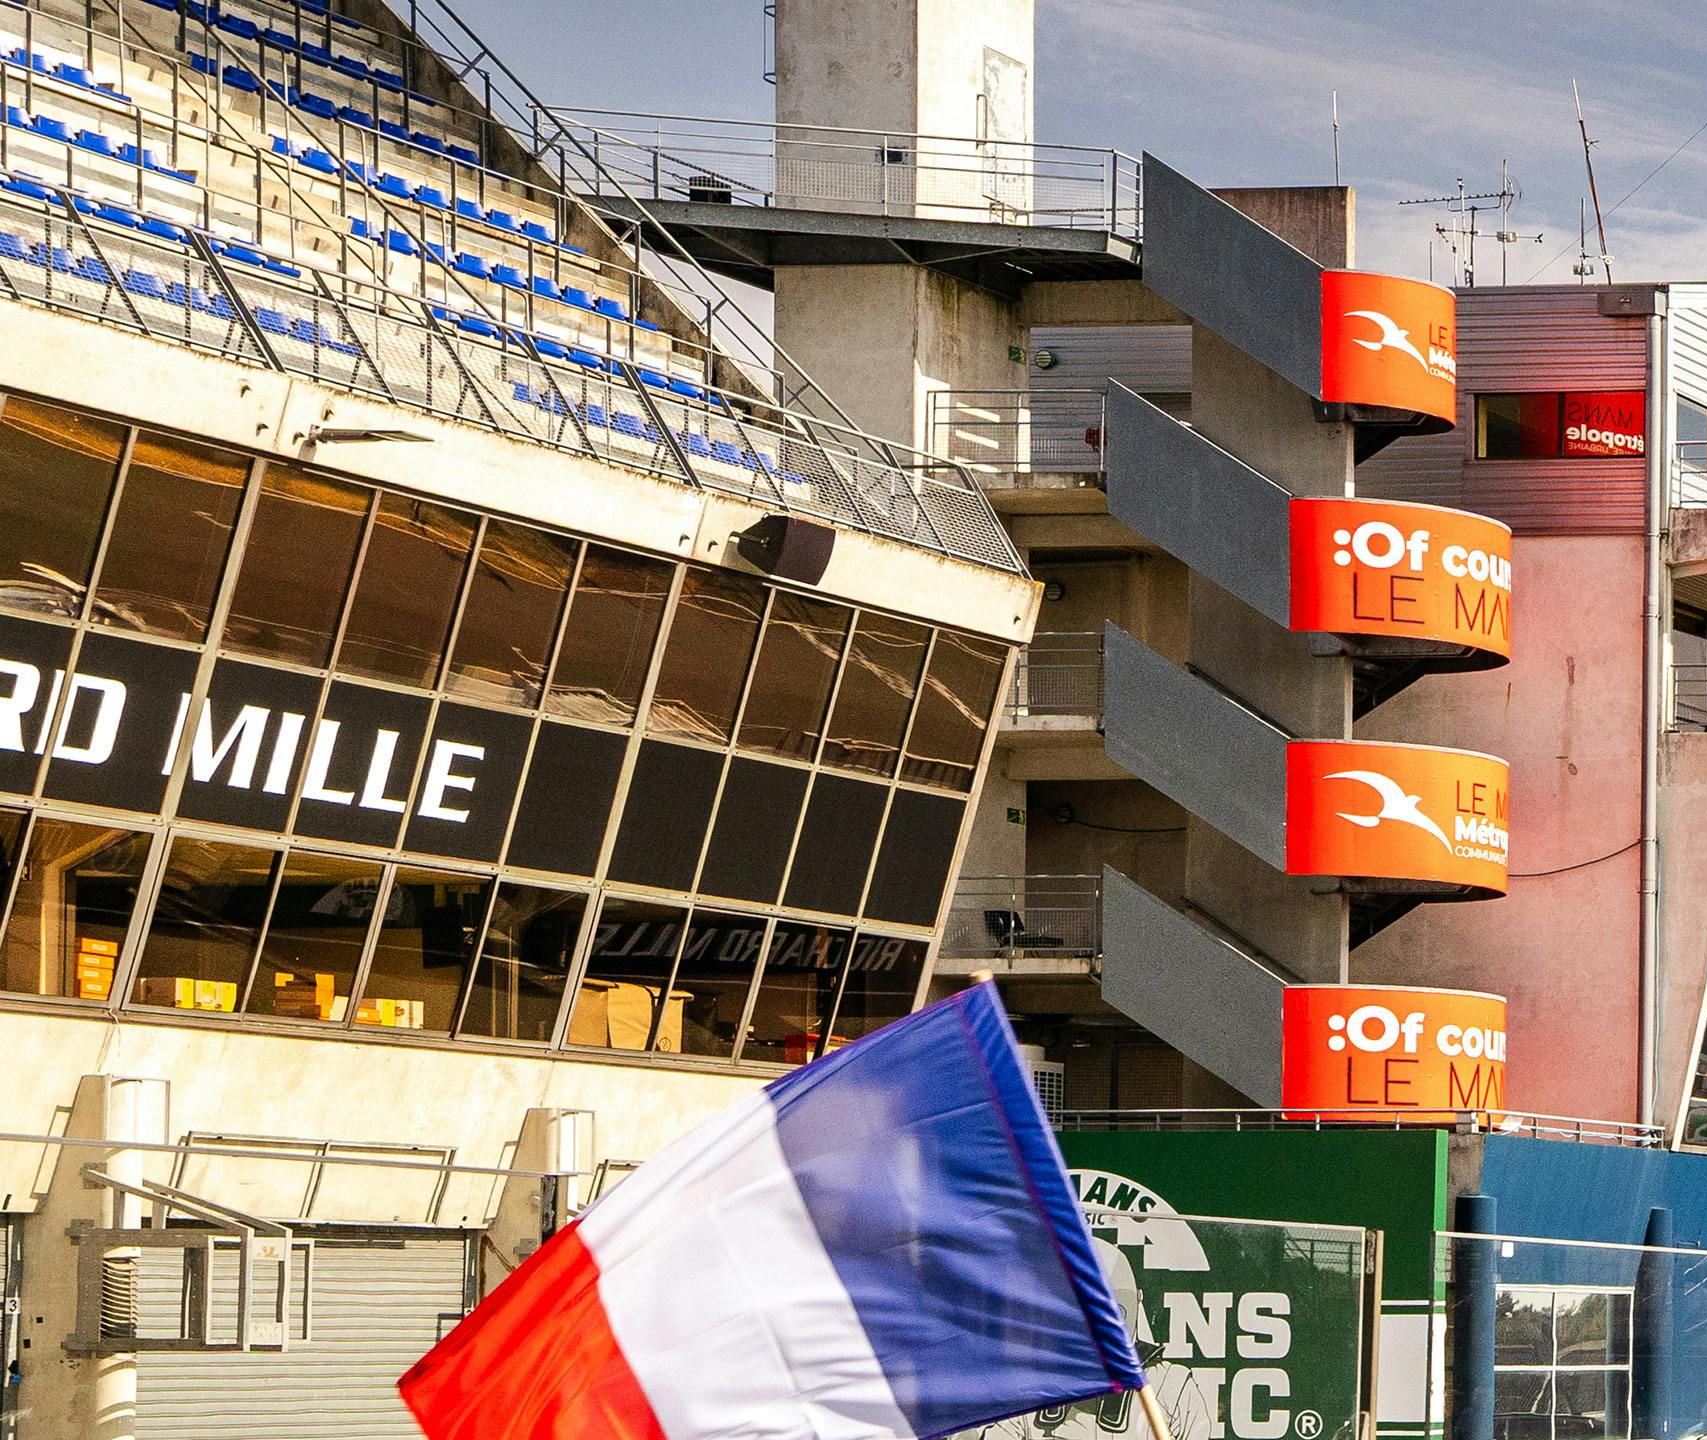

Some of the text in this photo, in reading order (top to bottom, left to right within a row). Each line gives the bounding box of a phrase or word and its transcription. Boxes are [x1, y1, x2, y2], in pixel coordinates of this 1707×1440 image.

[1429, 322, 1447, 349] LE
[1353, 572, 1425, 624] LE
[162, 694, 485, 823] MILLE
[1457, 780, 1486, 816] LE
[1347, 1057, 1419, 1106] LE
[1138, 1291, 1291, 1360] NS
